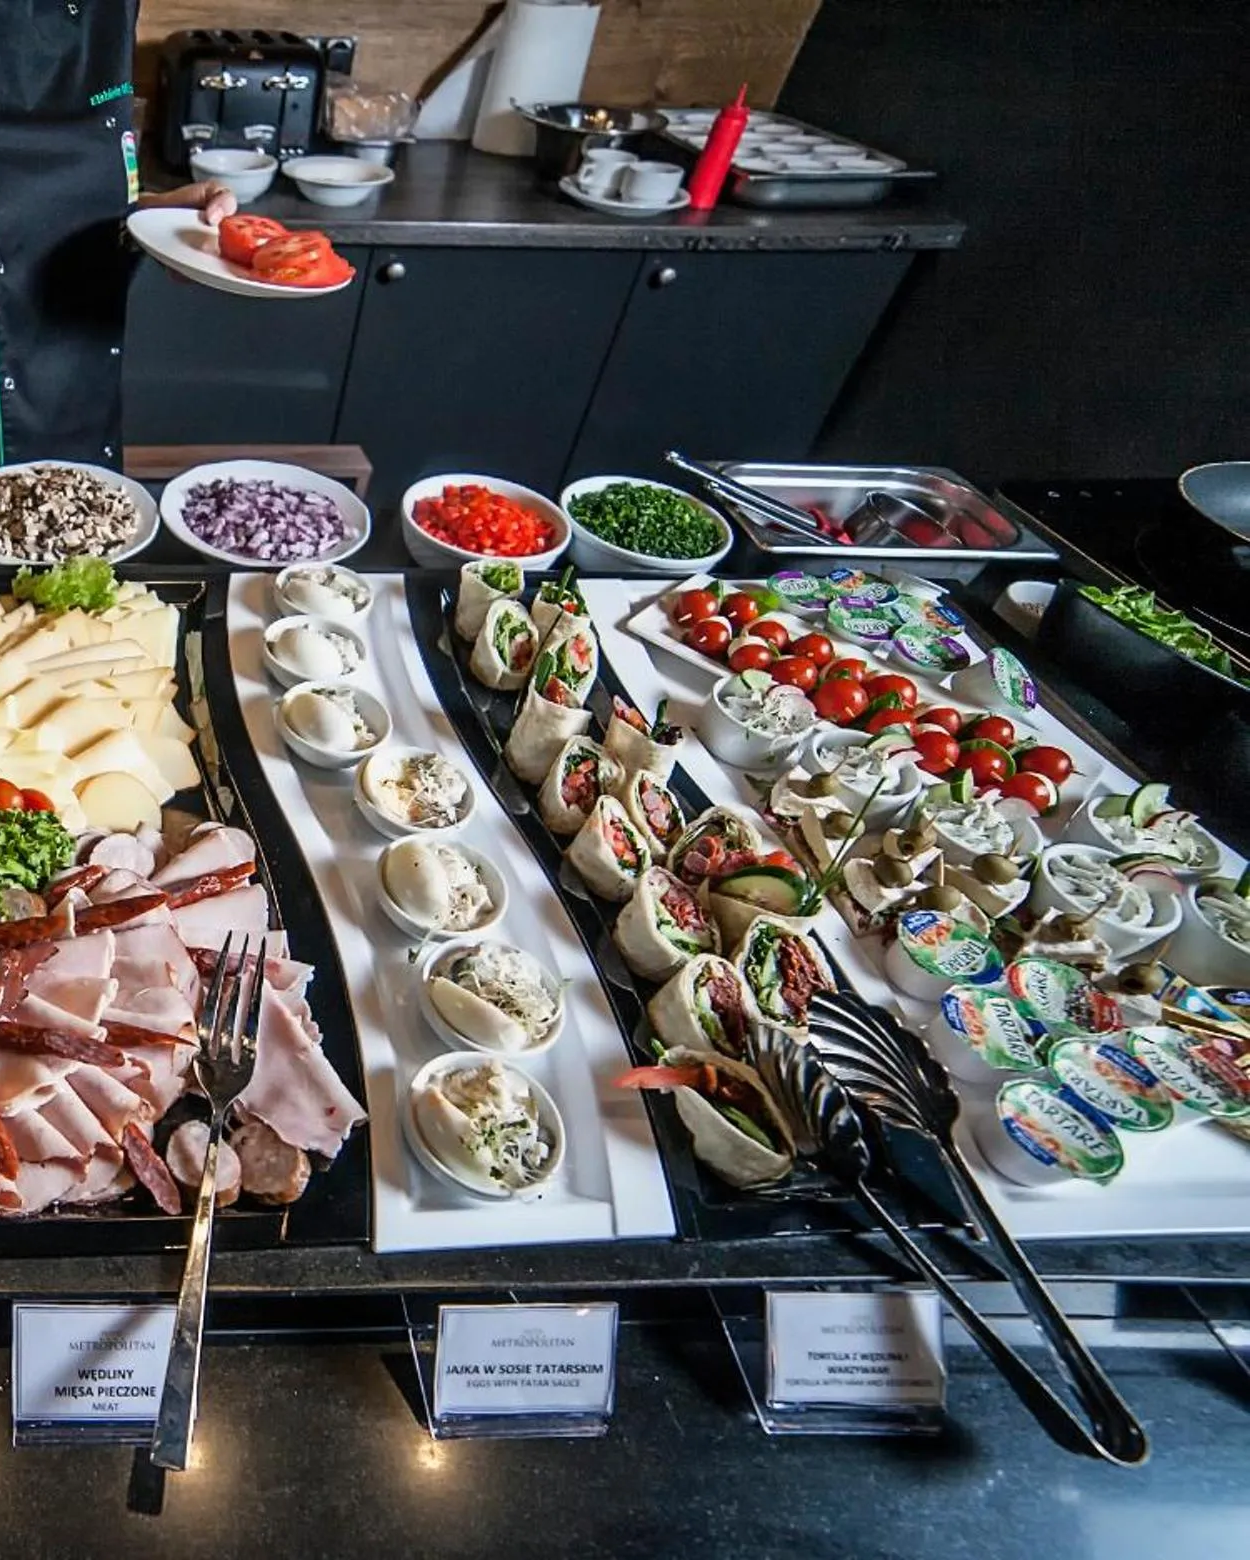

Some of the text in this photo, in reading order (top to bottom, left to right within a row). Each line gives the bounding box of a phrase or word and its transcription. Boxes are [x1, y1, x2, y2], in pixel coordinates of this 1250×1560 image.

[990, 1001, 1032, 1065] TARTARE
[1025, 1090, 1106, 1155] TARTARE
[78, 1368, 134, 1382] WĘDLINY
[446, 1363, 604, 1375] JAJKA W SOSIE TATARSKIM
[54, 1386, 157, 1400] MIĘSA PIECZONE
[91, 1402, 120, 1412] MEAT
